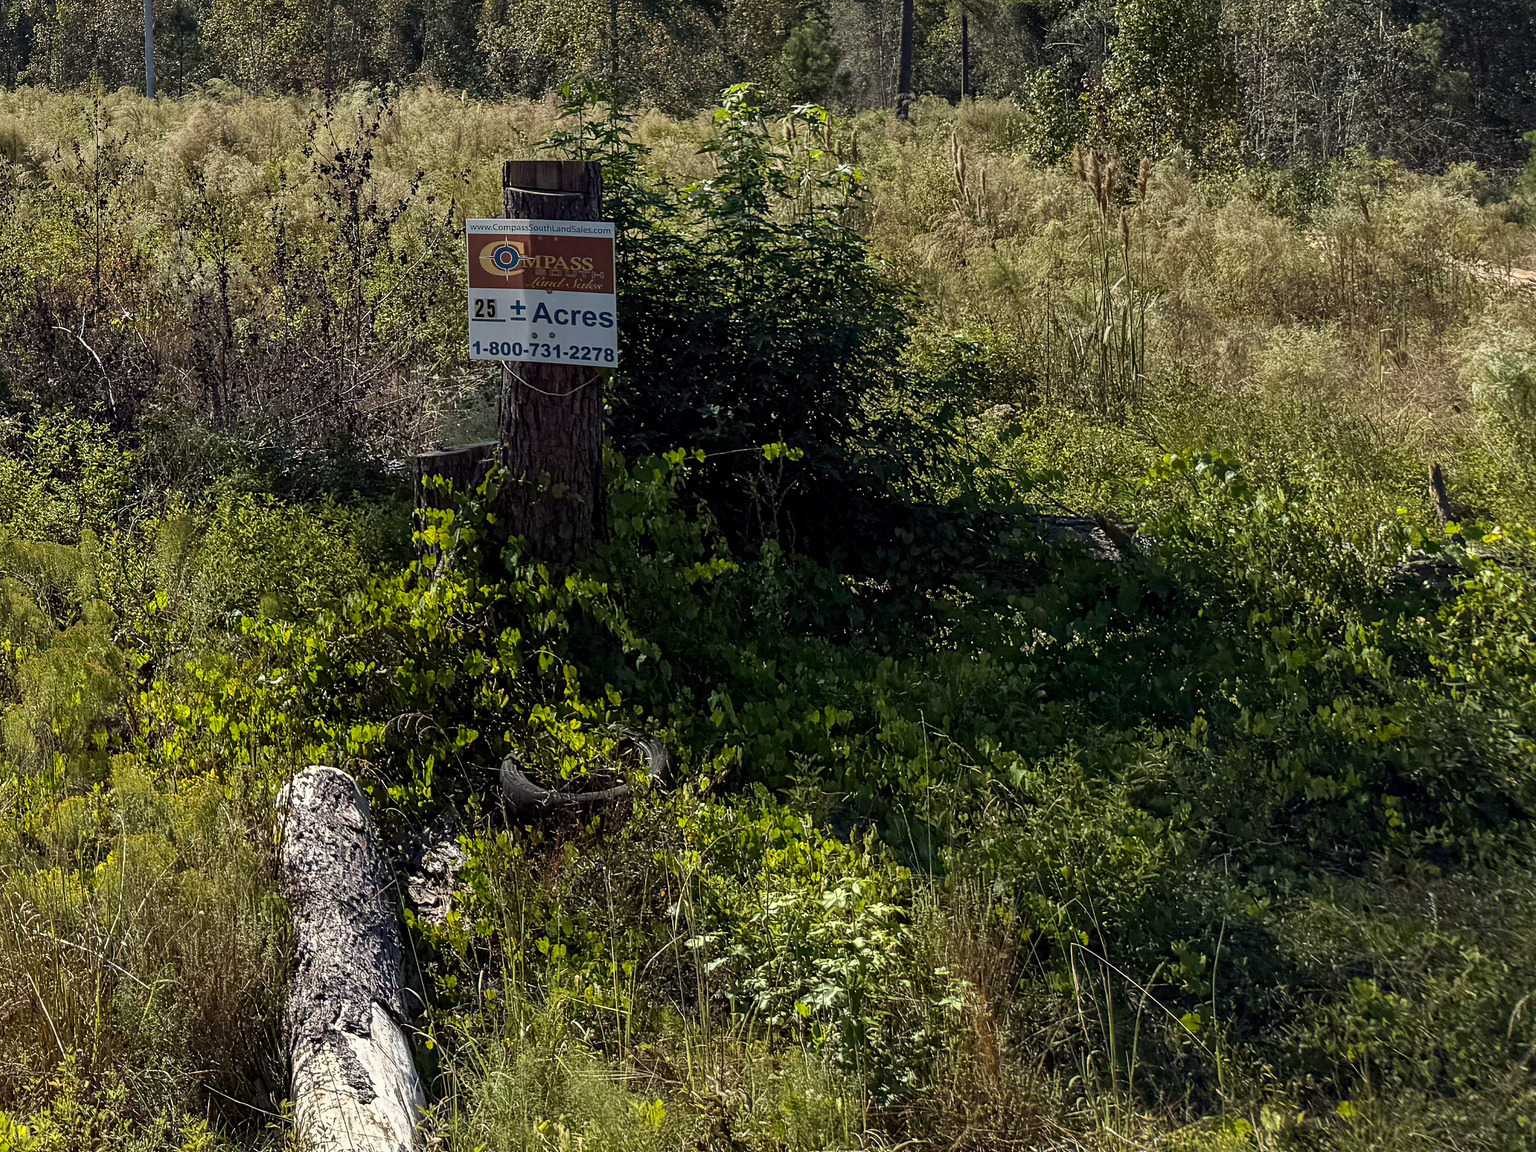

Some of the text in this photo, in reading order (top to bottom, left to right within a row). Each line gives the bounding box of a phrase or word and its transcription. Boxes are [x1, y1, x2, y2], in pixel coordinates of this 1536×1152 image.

[469, 223, 611, 235] www.CompassSouthLandSales.com
[478, 239, 594, 277] COMPASS
[534, 268, 605, 279] SOUTH
[526, 276, 603, 290] Land Sales
[474, 298, 496, 318] 25
[532, 302, 614, 328] Acres
[472, 341, 615, 362] 1-800-731-2278
